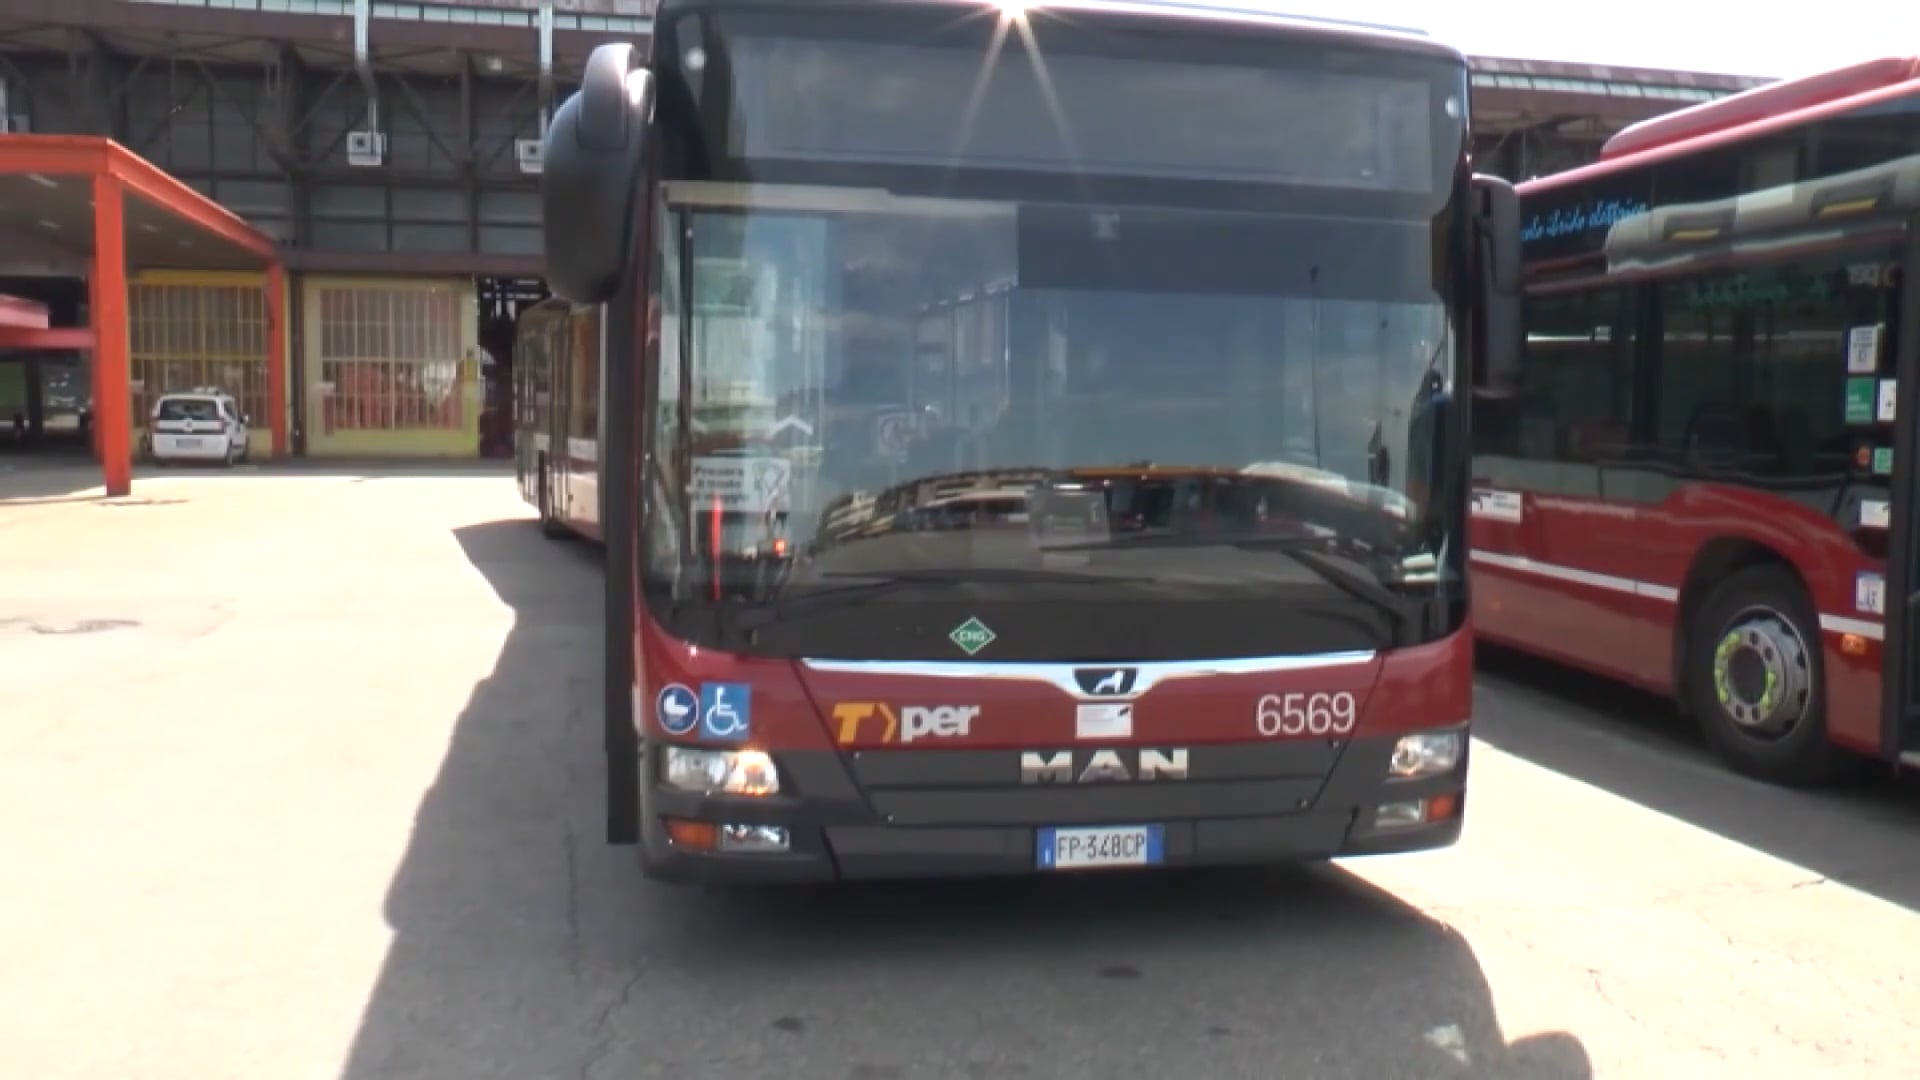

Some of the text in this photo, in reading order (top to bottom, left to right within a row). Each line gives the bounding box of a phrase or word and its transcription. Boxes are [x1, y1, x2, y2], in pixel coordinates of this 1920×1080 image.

[958, 631, 985, 642] CNG
[1256, 691, 1356, 736] 6569
[1021, 748, 1188, 783] MAN
